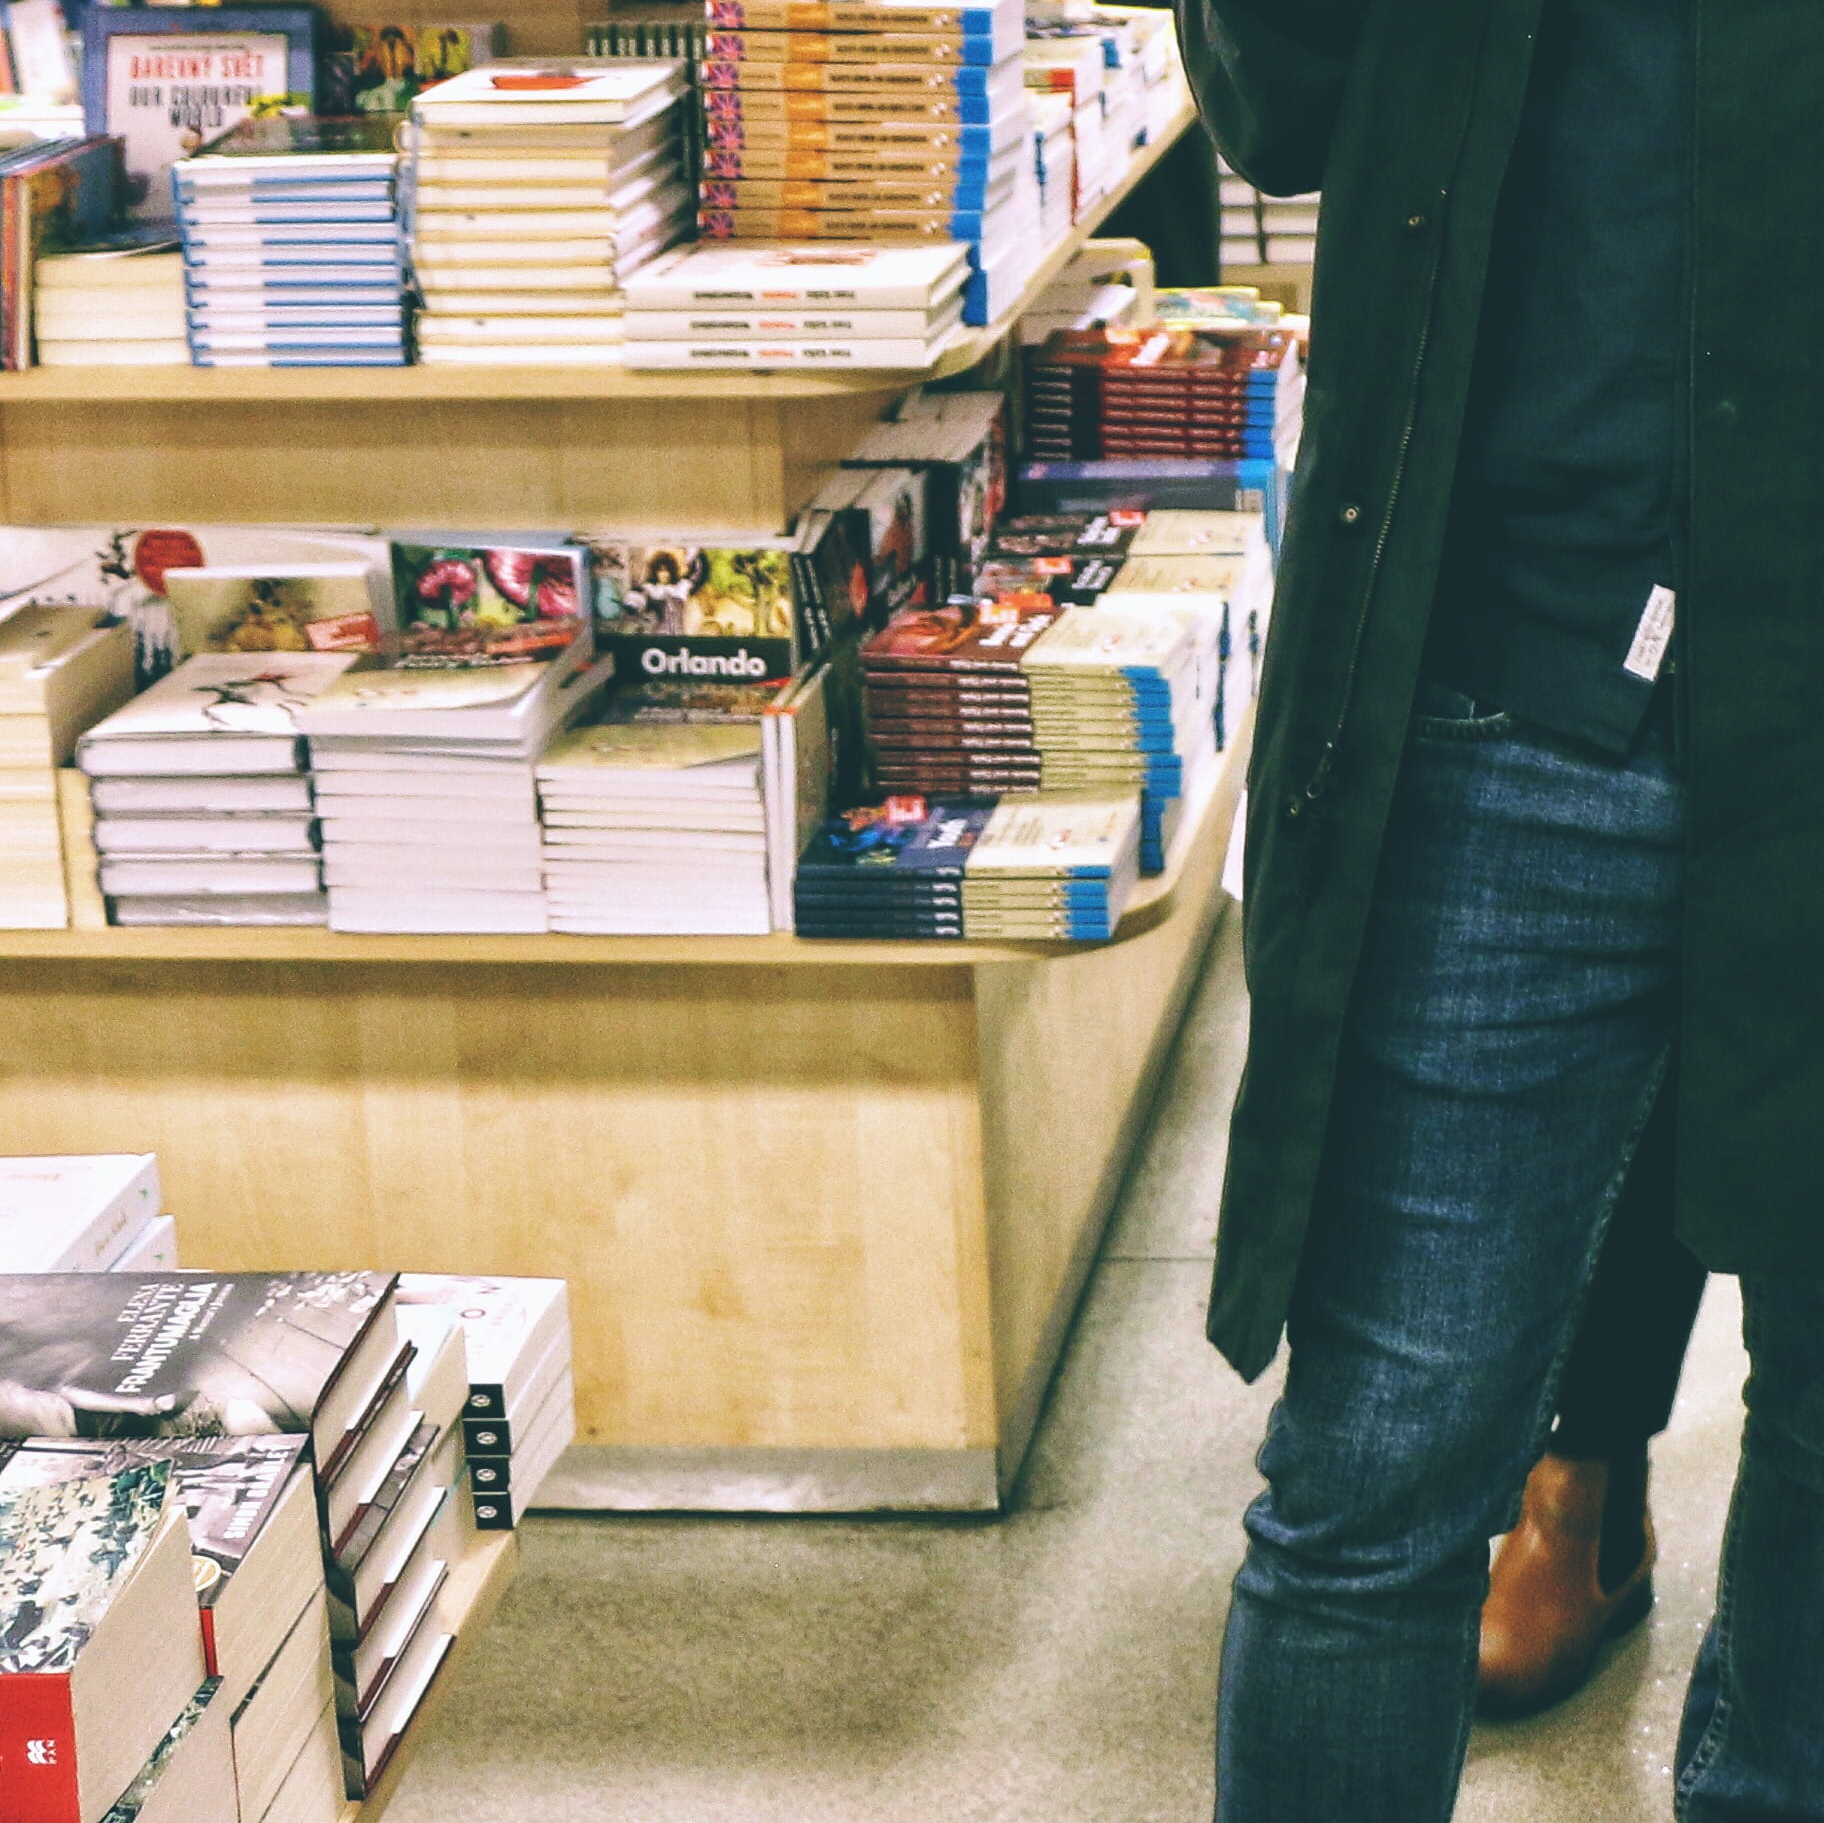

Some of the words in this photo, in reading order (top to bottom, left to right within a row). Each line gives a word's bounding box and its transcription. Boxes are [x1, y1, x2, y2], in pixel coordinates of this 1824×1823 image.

[640, 647, 768, 679] Orlando
[110, 1283, 188, 1362] FERRANTE
[114, 1282, 219, 1394] FRANTUMAGLIA
[47, 1739, 57, 1765] PAN
